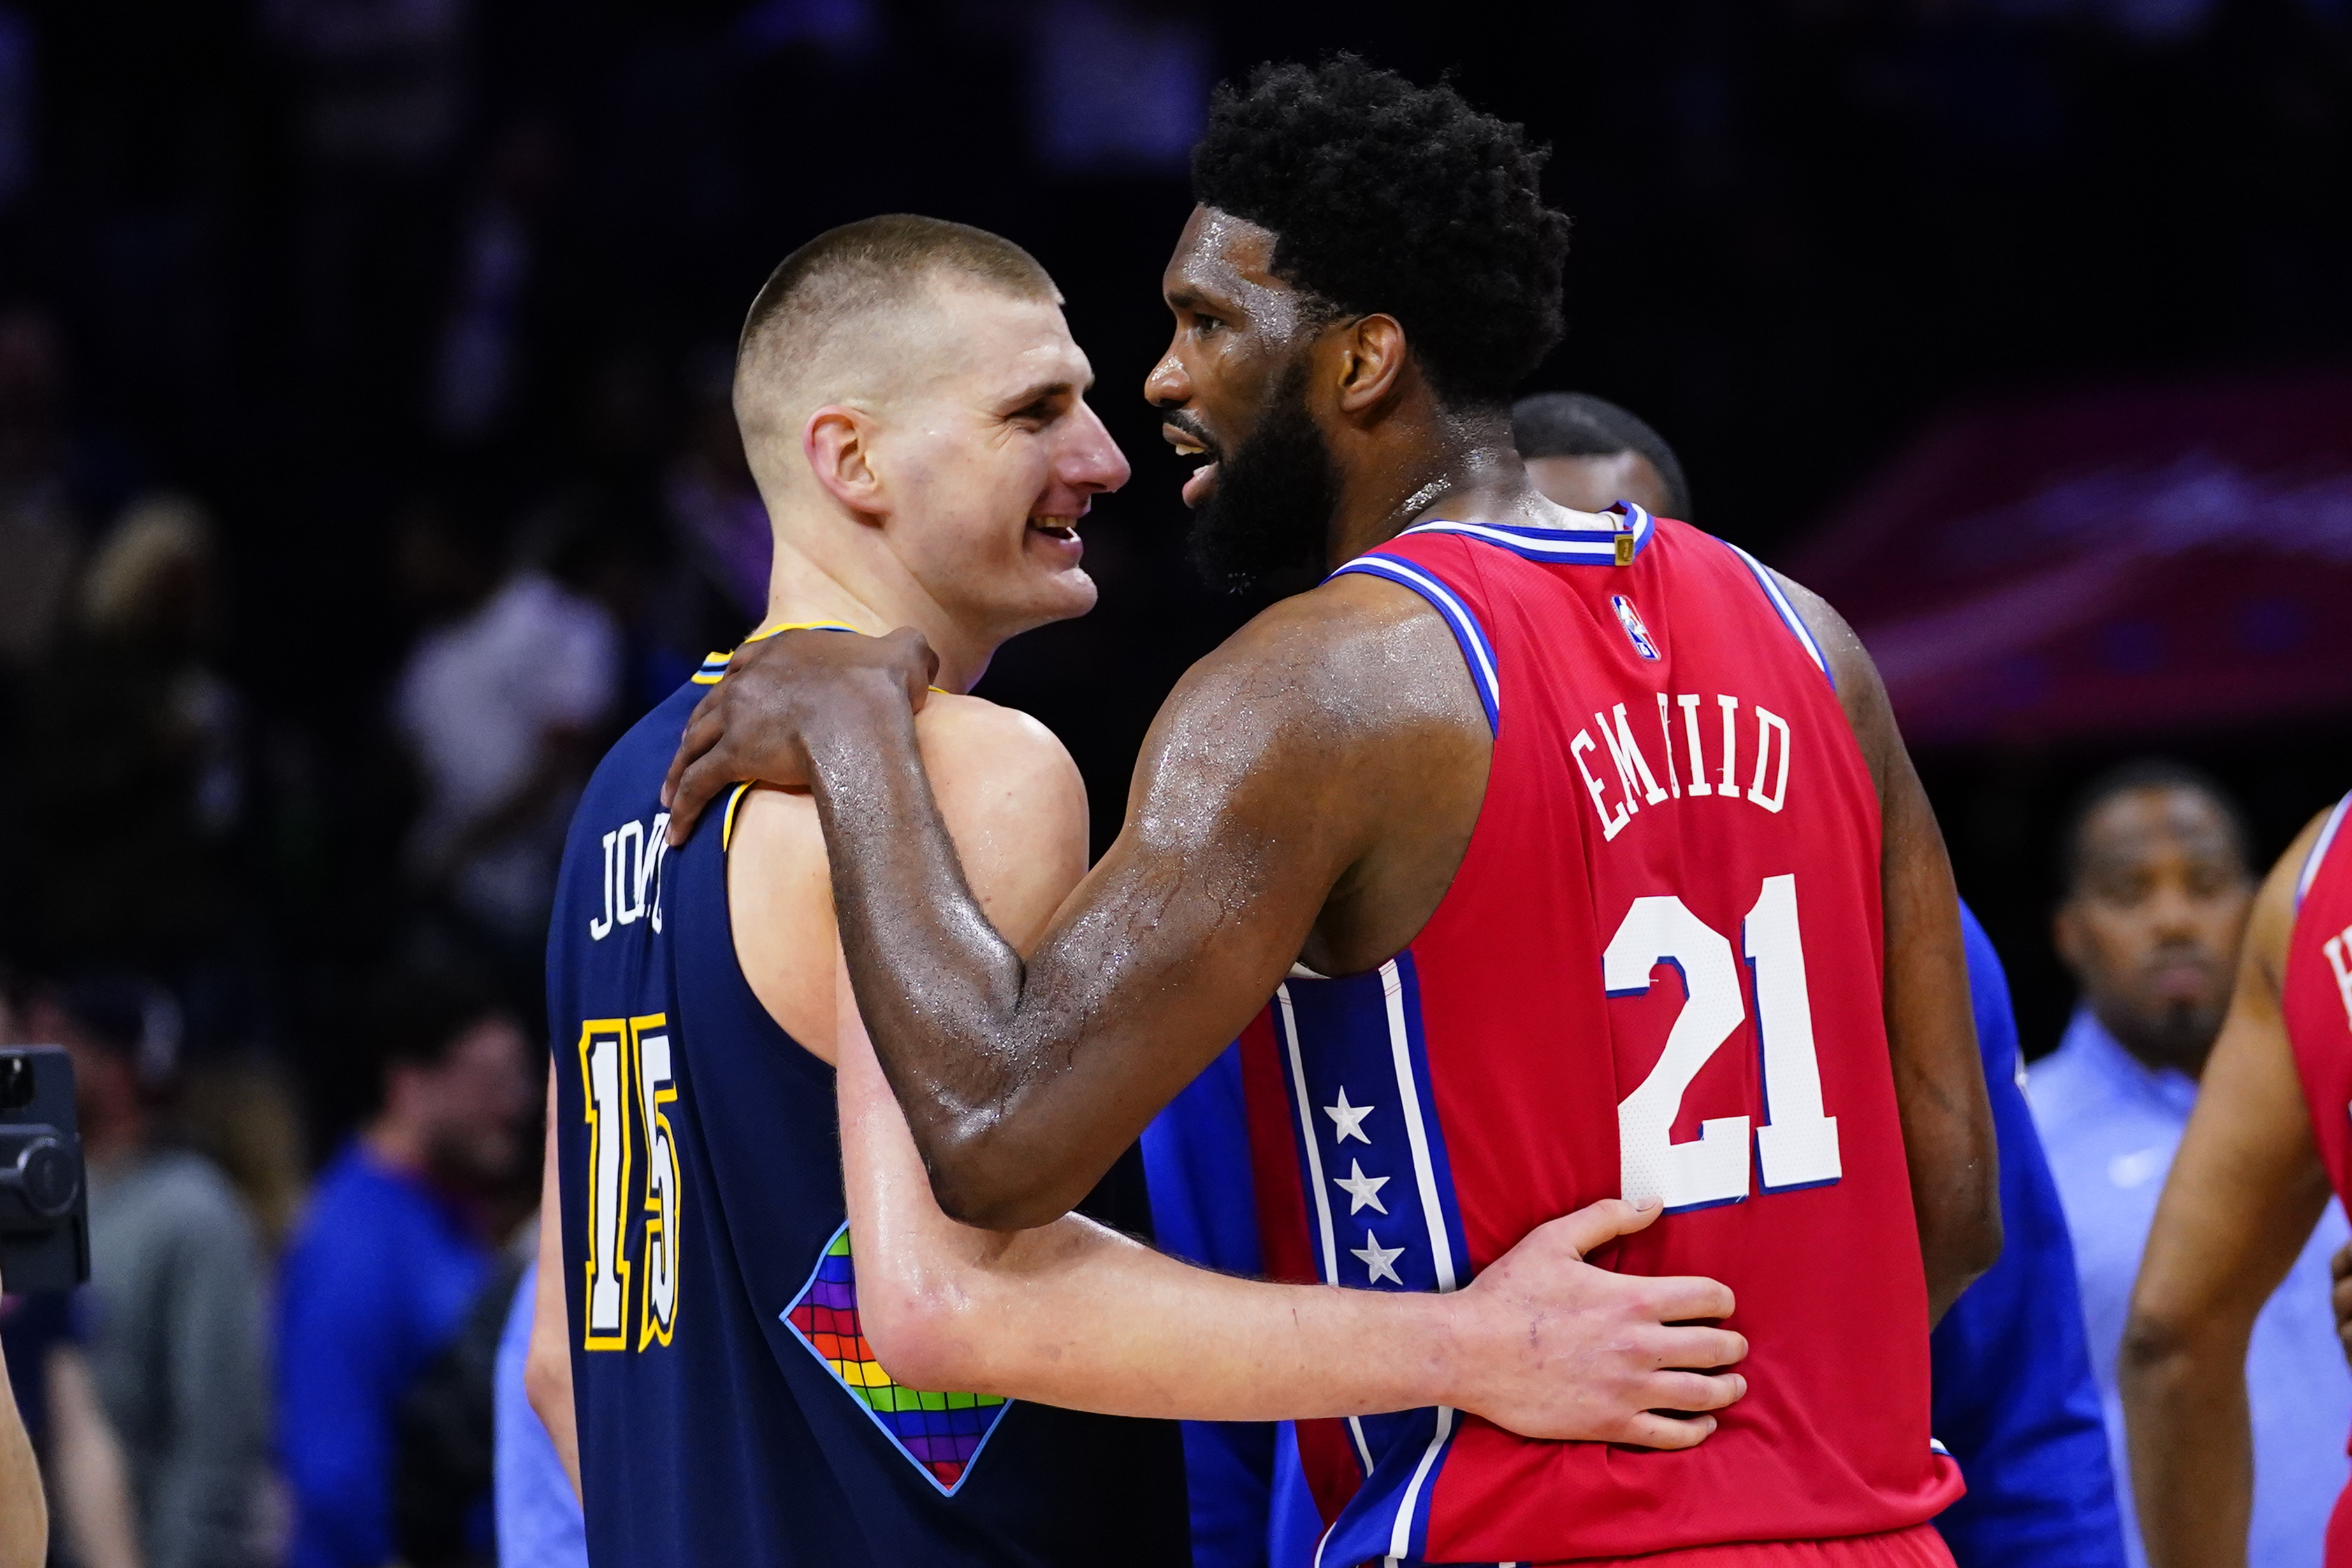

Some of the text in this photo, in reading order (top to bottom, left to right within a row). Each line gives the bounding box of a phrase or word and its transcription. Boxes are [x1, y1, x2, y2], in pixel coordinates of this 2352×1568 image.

[1569, 692, 1790, 842] EMIID
[578, 1012, 681, 1353] 15
[1601, 873, 1842, 1215] 21
